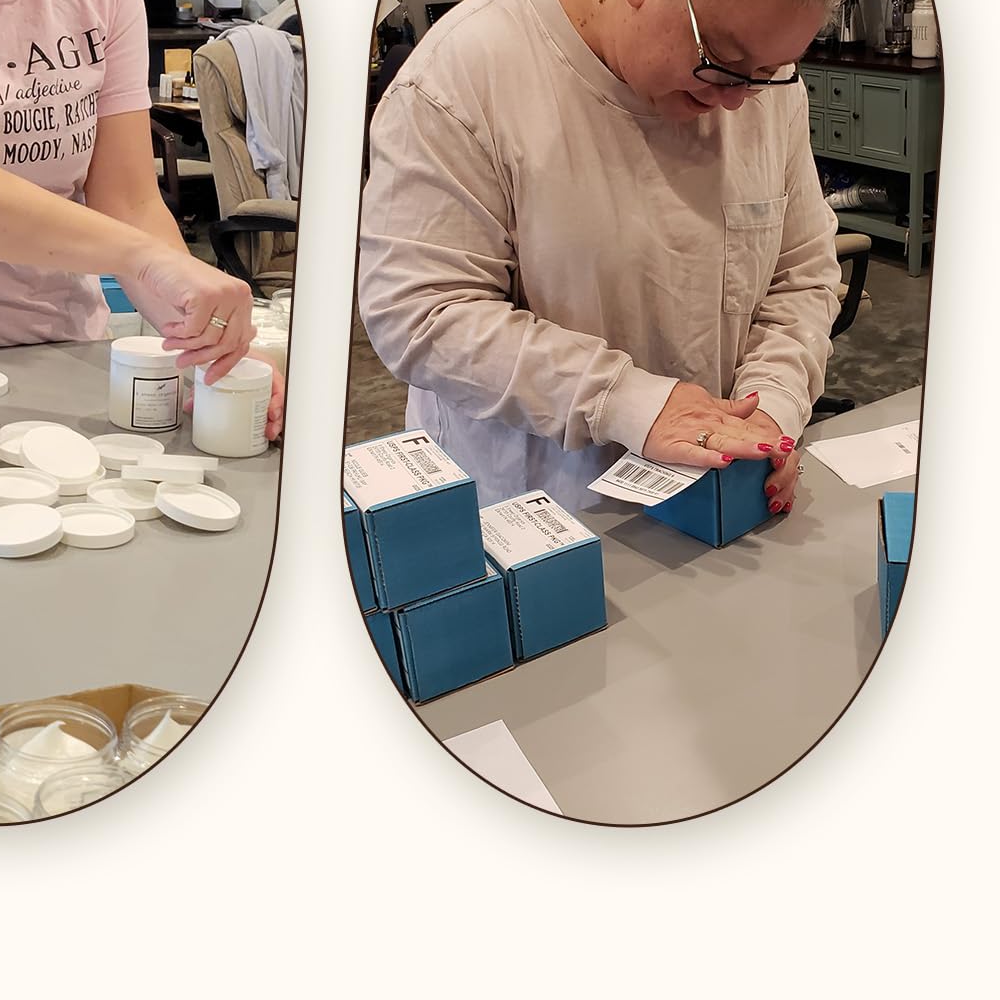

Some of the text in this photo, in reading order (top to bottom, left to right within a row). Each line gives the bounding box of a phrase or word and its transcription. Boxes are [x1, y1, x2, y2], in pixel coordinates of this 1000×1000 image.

[16, 78, 83, 104] adjective
[3, 106, 60, 135] BOUGIE,
[3, 138, 65, 165] MOODY,
[402, 436, 430, 445] F
[526, 496, 550, 505] F
